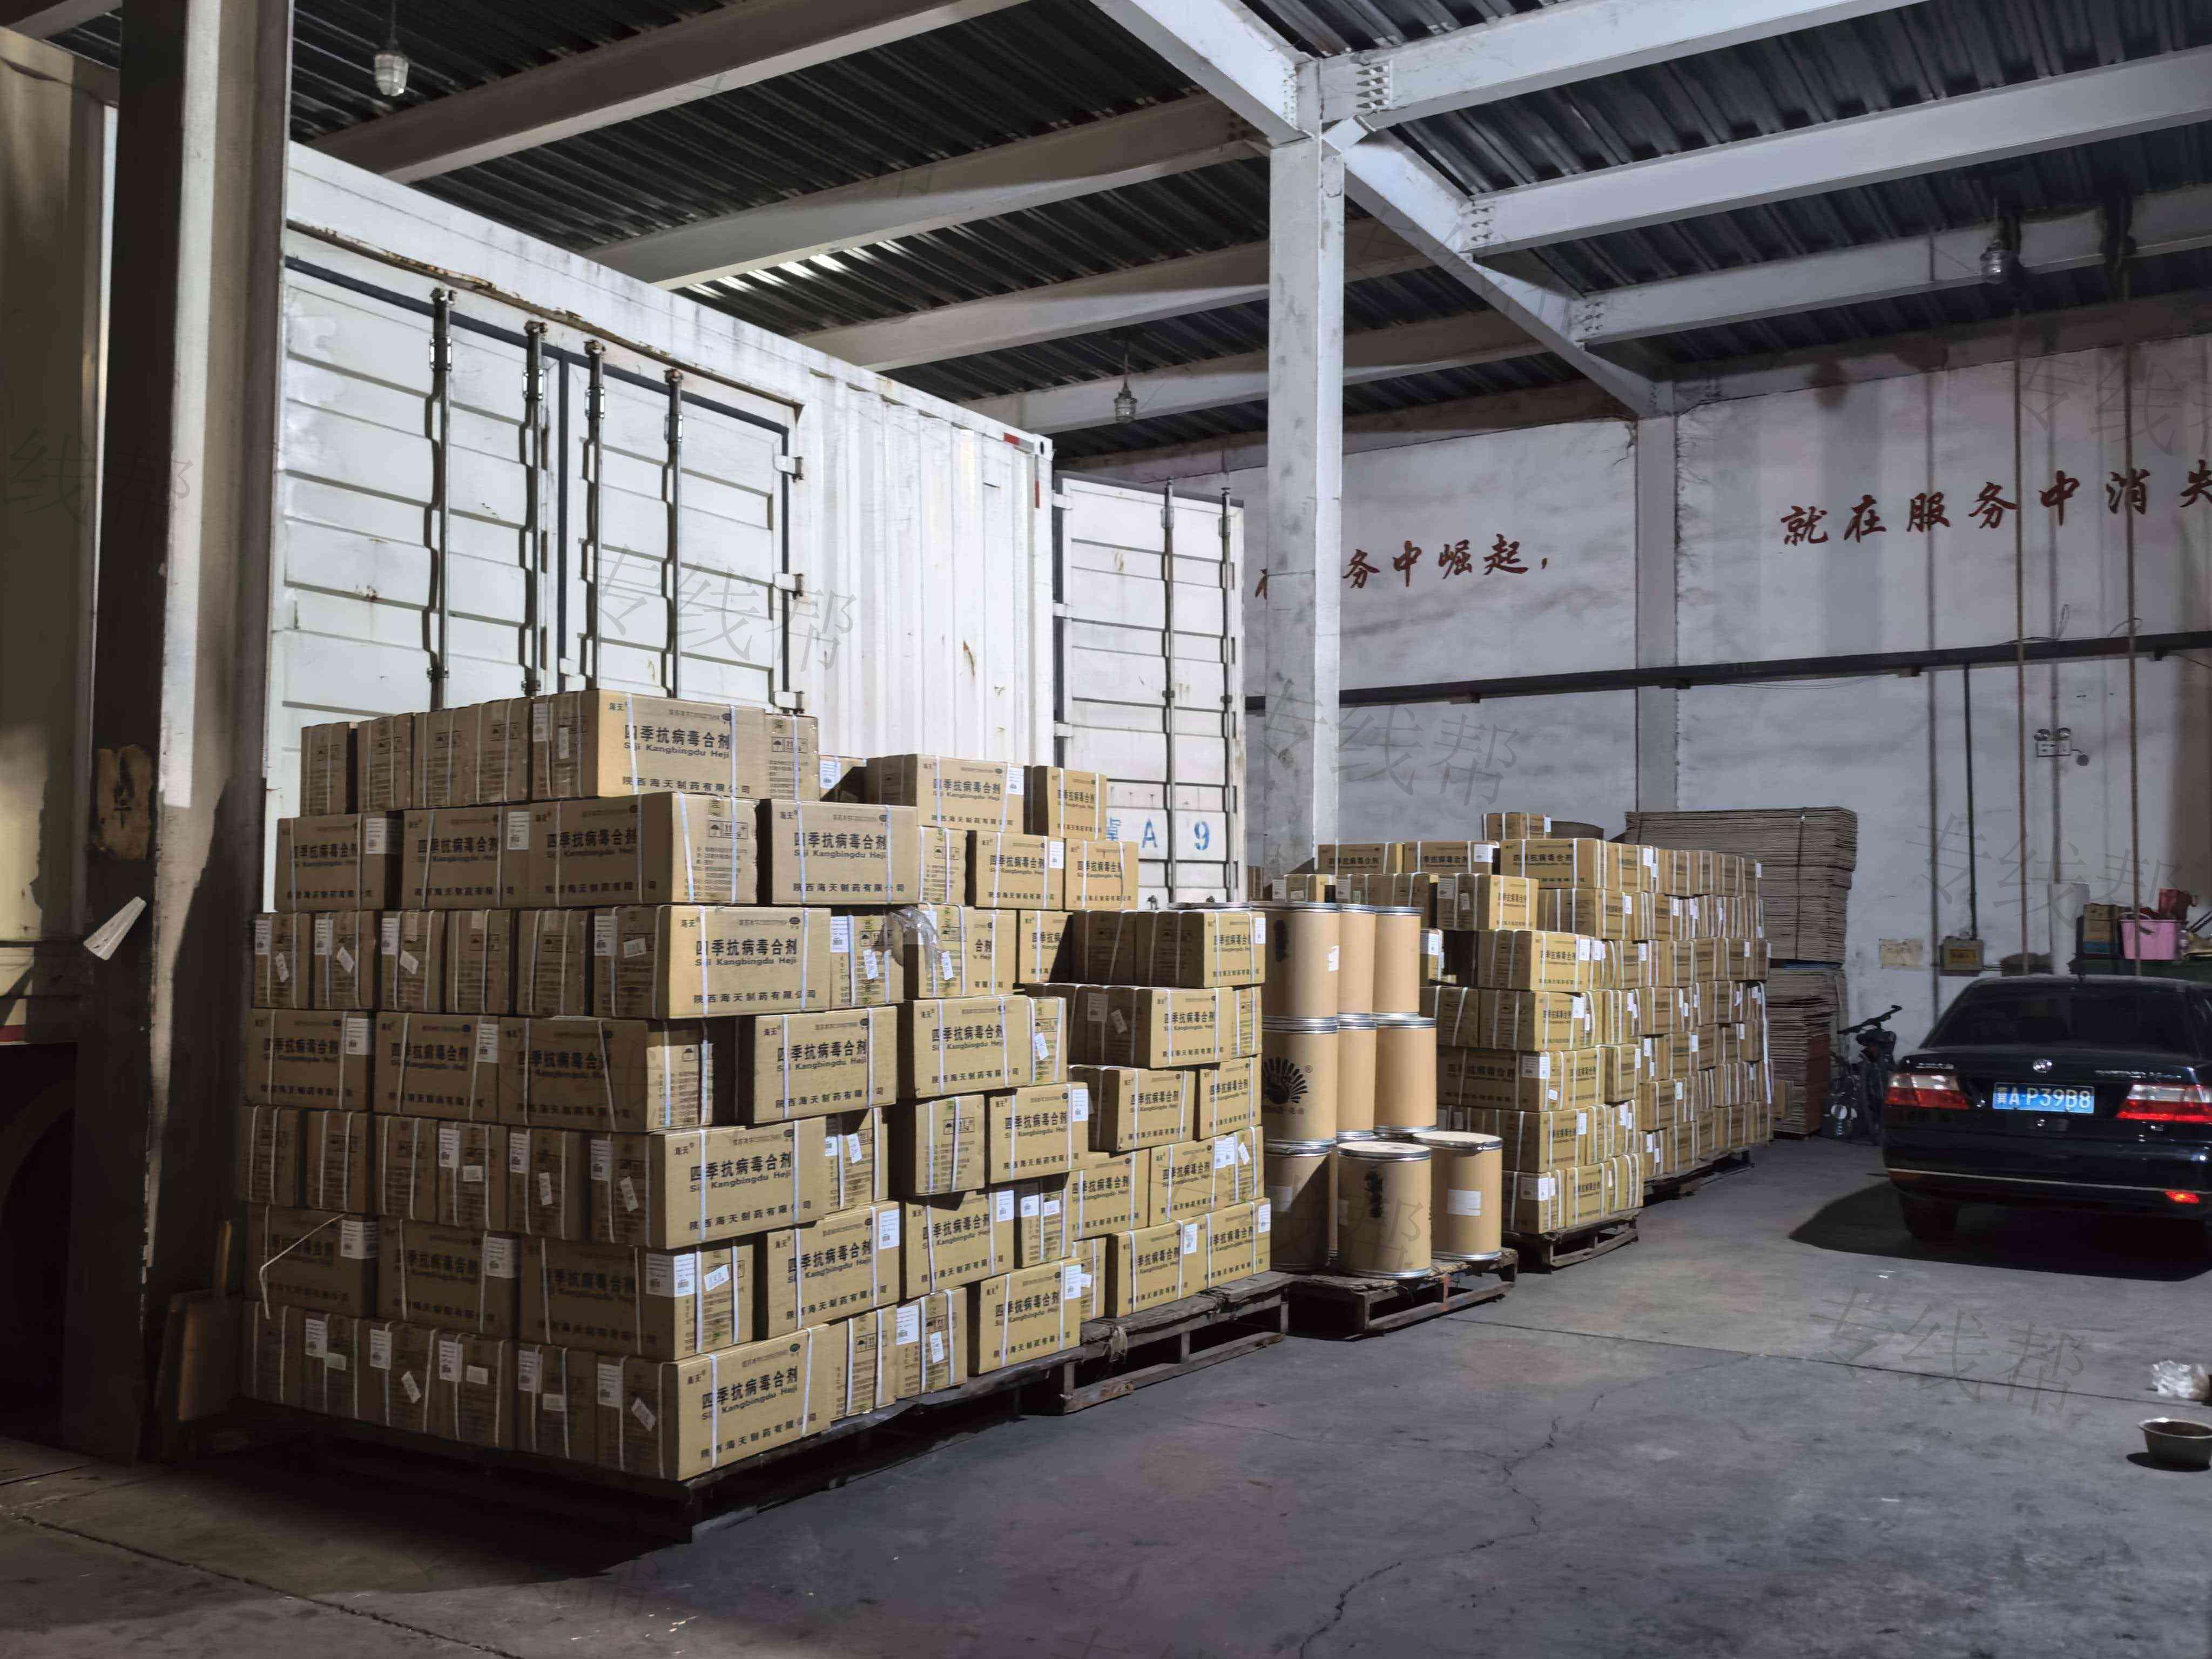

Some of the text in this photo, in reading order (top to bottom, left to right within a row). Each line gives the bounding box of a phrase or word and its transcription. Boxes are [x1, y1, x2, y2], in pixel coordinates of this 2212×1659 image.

[1781, 460, 2212, 545] 就在服务中消失
[625, 725, 730, 749] 四季抗病毒合剂
[624, 743, 730, 759] Sji Kangbingdu Heji
[622, 777, 750, 793] 陕西海天制药有限司
[931, 816, 1014, 826] 陕西海天制药有限司
[794, 832, 887, 850] 四季抗病毒合剂
[813, 851, 866, 859] Kangbingdu
[794, 884, 904, 893] 陕西海天制药有限司
[696, 939, 797, 956] 四季抗病毒合剂
[717, 957, 774, 966] Kangbingdu
[779, 957, 797, 966] Heji
[932, 1023, 1004, 1042] 四季抗病毒合剂
[778, 1040, 867, 1062] 四季抗病毒合剂
[947, 1041, 988, 1050] Kangbingdu
[797, 1059, 847, 1070] Kangbingdu
[932, 1068, 1019, 1083] 陕西海天制药有限司
[775, 1087, 884, 1108] 陕西海天制药有限司
[1005, 1112, 1068, 1131] 四季抗病毒合剂
[690, 1152, 792, 1182] 四季抗病毒合剂
[1004, 1152, 1078, 1170] 陕西海天制药有限司
[712, 1174, 770, 1190] Kangbingdu
[774, 1171, 792, 1182] Heji
[689, 1201, 811, 1231] 陕西海天制药有限司
[922, 1213, 990, 1240] 四季抗病毒合剂
[788, 1239, 872, 1274] 四季抗病毒合剂
[805, 1262, 853, 1280] Kangbingdu
[921, 1255, 1003, 1283] 陕海天制药有限司
[786, 1285, 887, 1320] 陕海天制药有限司
[995, 1291, 1060, 1317] 四季抗病毒合剂
[993, 1331, 1070, 1358] 陕海天制药有限司
[702, 1366, 798, 1410] 四季抗病毒合剂
[722, 1391, 777, 1414] Kangbingdu
